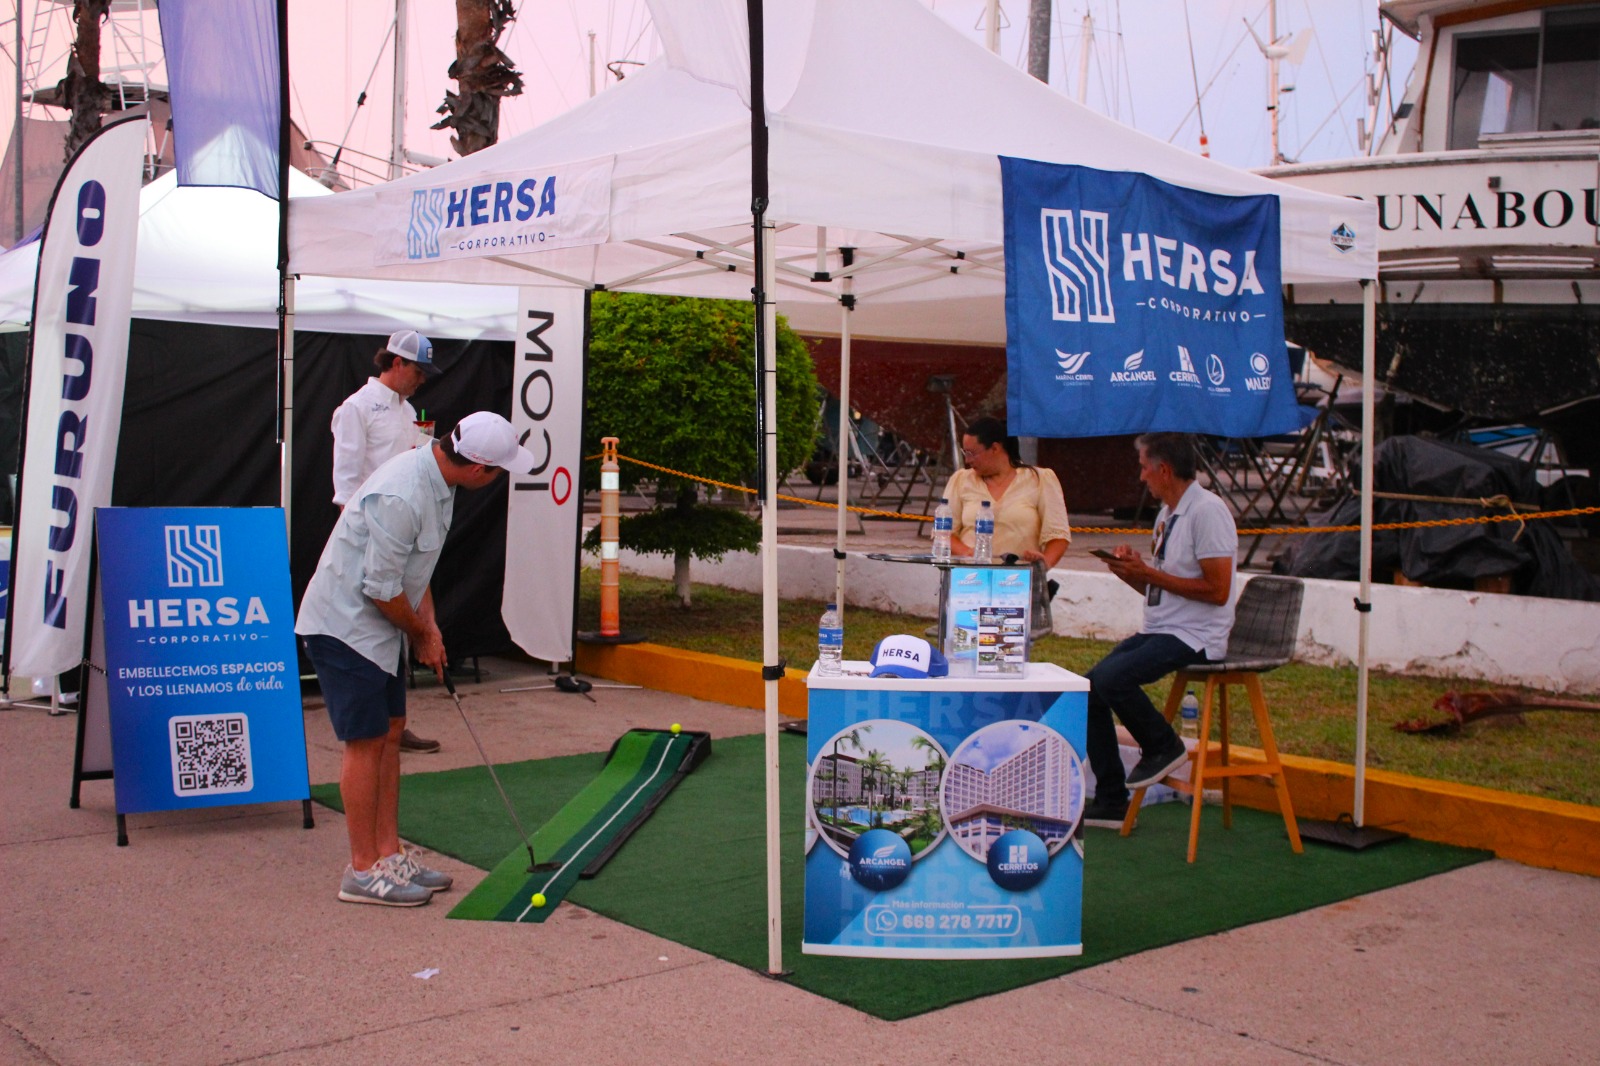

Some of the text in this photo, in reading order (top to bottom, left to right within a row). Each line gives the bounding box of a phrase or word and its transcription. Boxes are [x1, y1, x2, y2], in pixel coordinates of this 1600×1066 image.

[445, 175, 557, 229] HERSA
[1346, 188, 1600, 231] UNABOU
[458, 231, 546, 251] CORPORATIVO
[1121, 232, 1265, 297] HERSA
[1148, 297, 1250, 323] CORPORATIVO
[1110, 370, 1157, 383] ARCANGEL
[1169, 371, 1201, 384] CERRIT
[43, 179, 107, 630] FURUNO
[514, 309, 555, 491] ICOM
[128, 596, 270, 629] HERSA
[148, 633, 258, 644] CORPORATIVO
[882, 648, 920, 662] HERSA
[118, 661, 285, 679] EMBELLECEMOS ESPACIOS
[126, 675, 284, 697] Y LOS LLENAMOS de vida
[844, 689, 1045, 729] HERSA
[859, 857, 906, 867] ARCANGEL
[997, 862, 1039, 871] CERRITOS
[903, 914, 1013, 929] 669 278 7717
